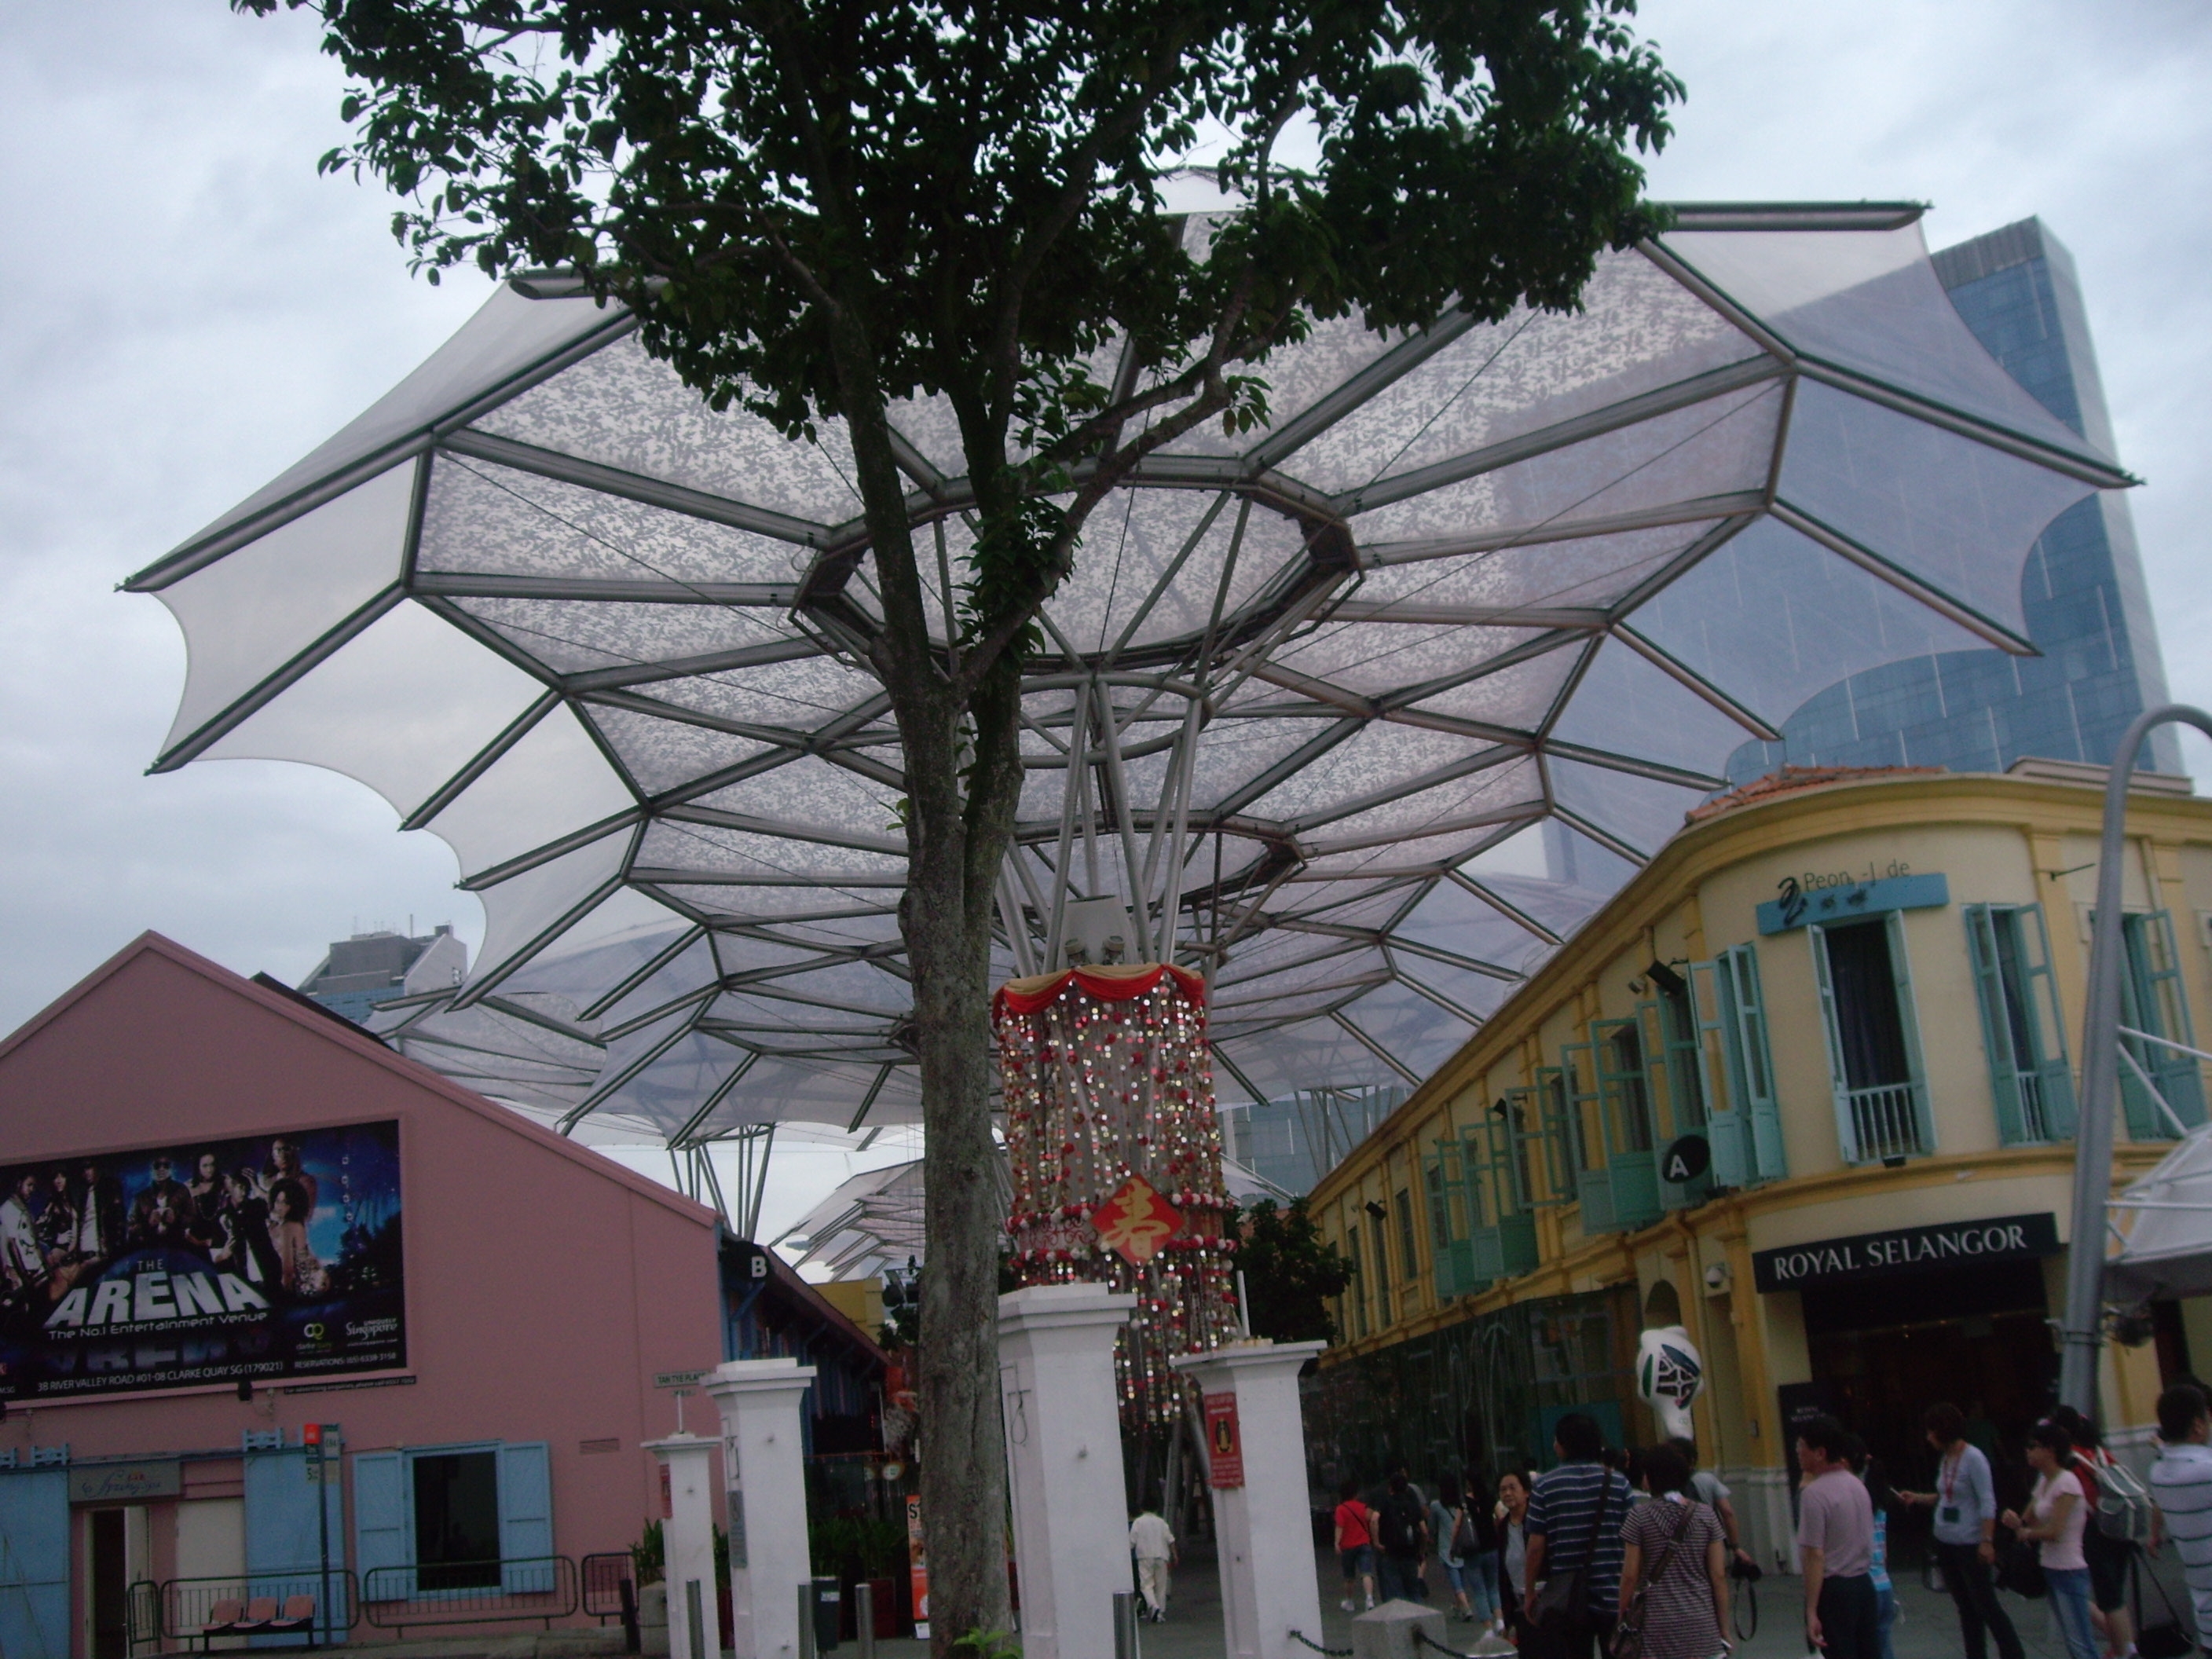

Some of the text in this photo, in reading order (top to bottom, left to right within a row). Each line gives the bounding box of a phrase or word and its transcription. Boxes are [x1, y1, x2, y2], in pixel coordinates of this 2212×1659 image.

[1669, 1154, 1690, 1178] A
[137, 1258, 164, 1271] THE
[1774, 1225, 2028, 1281] ROYAL SELANGOR
[751, 1255, 767, 1278] B
[42, 1271, 272, 1328] ARENA
[48, 1329, 76, 1340] The
[110, 1317, 215, 1335] Entertainment
[219, 1311, 269, 1325] Venue
[49, 1379, 75, 1391] RIVER
[75, 1376, 108, 1389] VALLEY
[108, 1374, 134, 1386] ROAD
[167, 1368, 202, 1380] CLARKE
[202, 1365, 229, 1378] QUAY
[230, 1365, 244, 1375] SG
